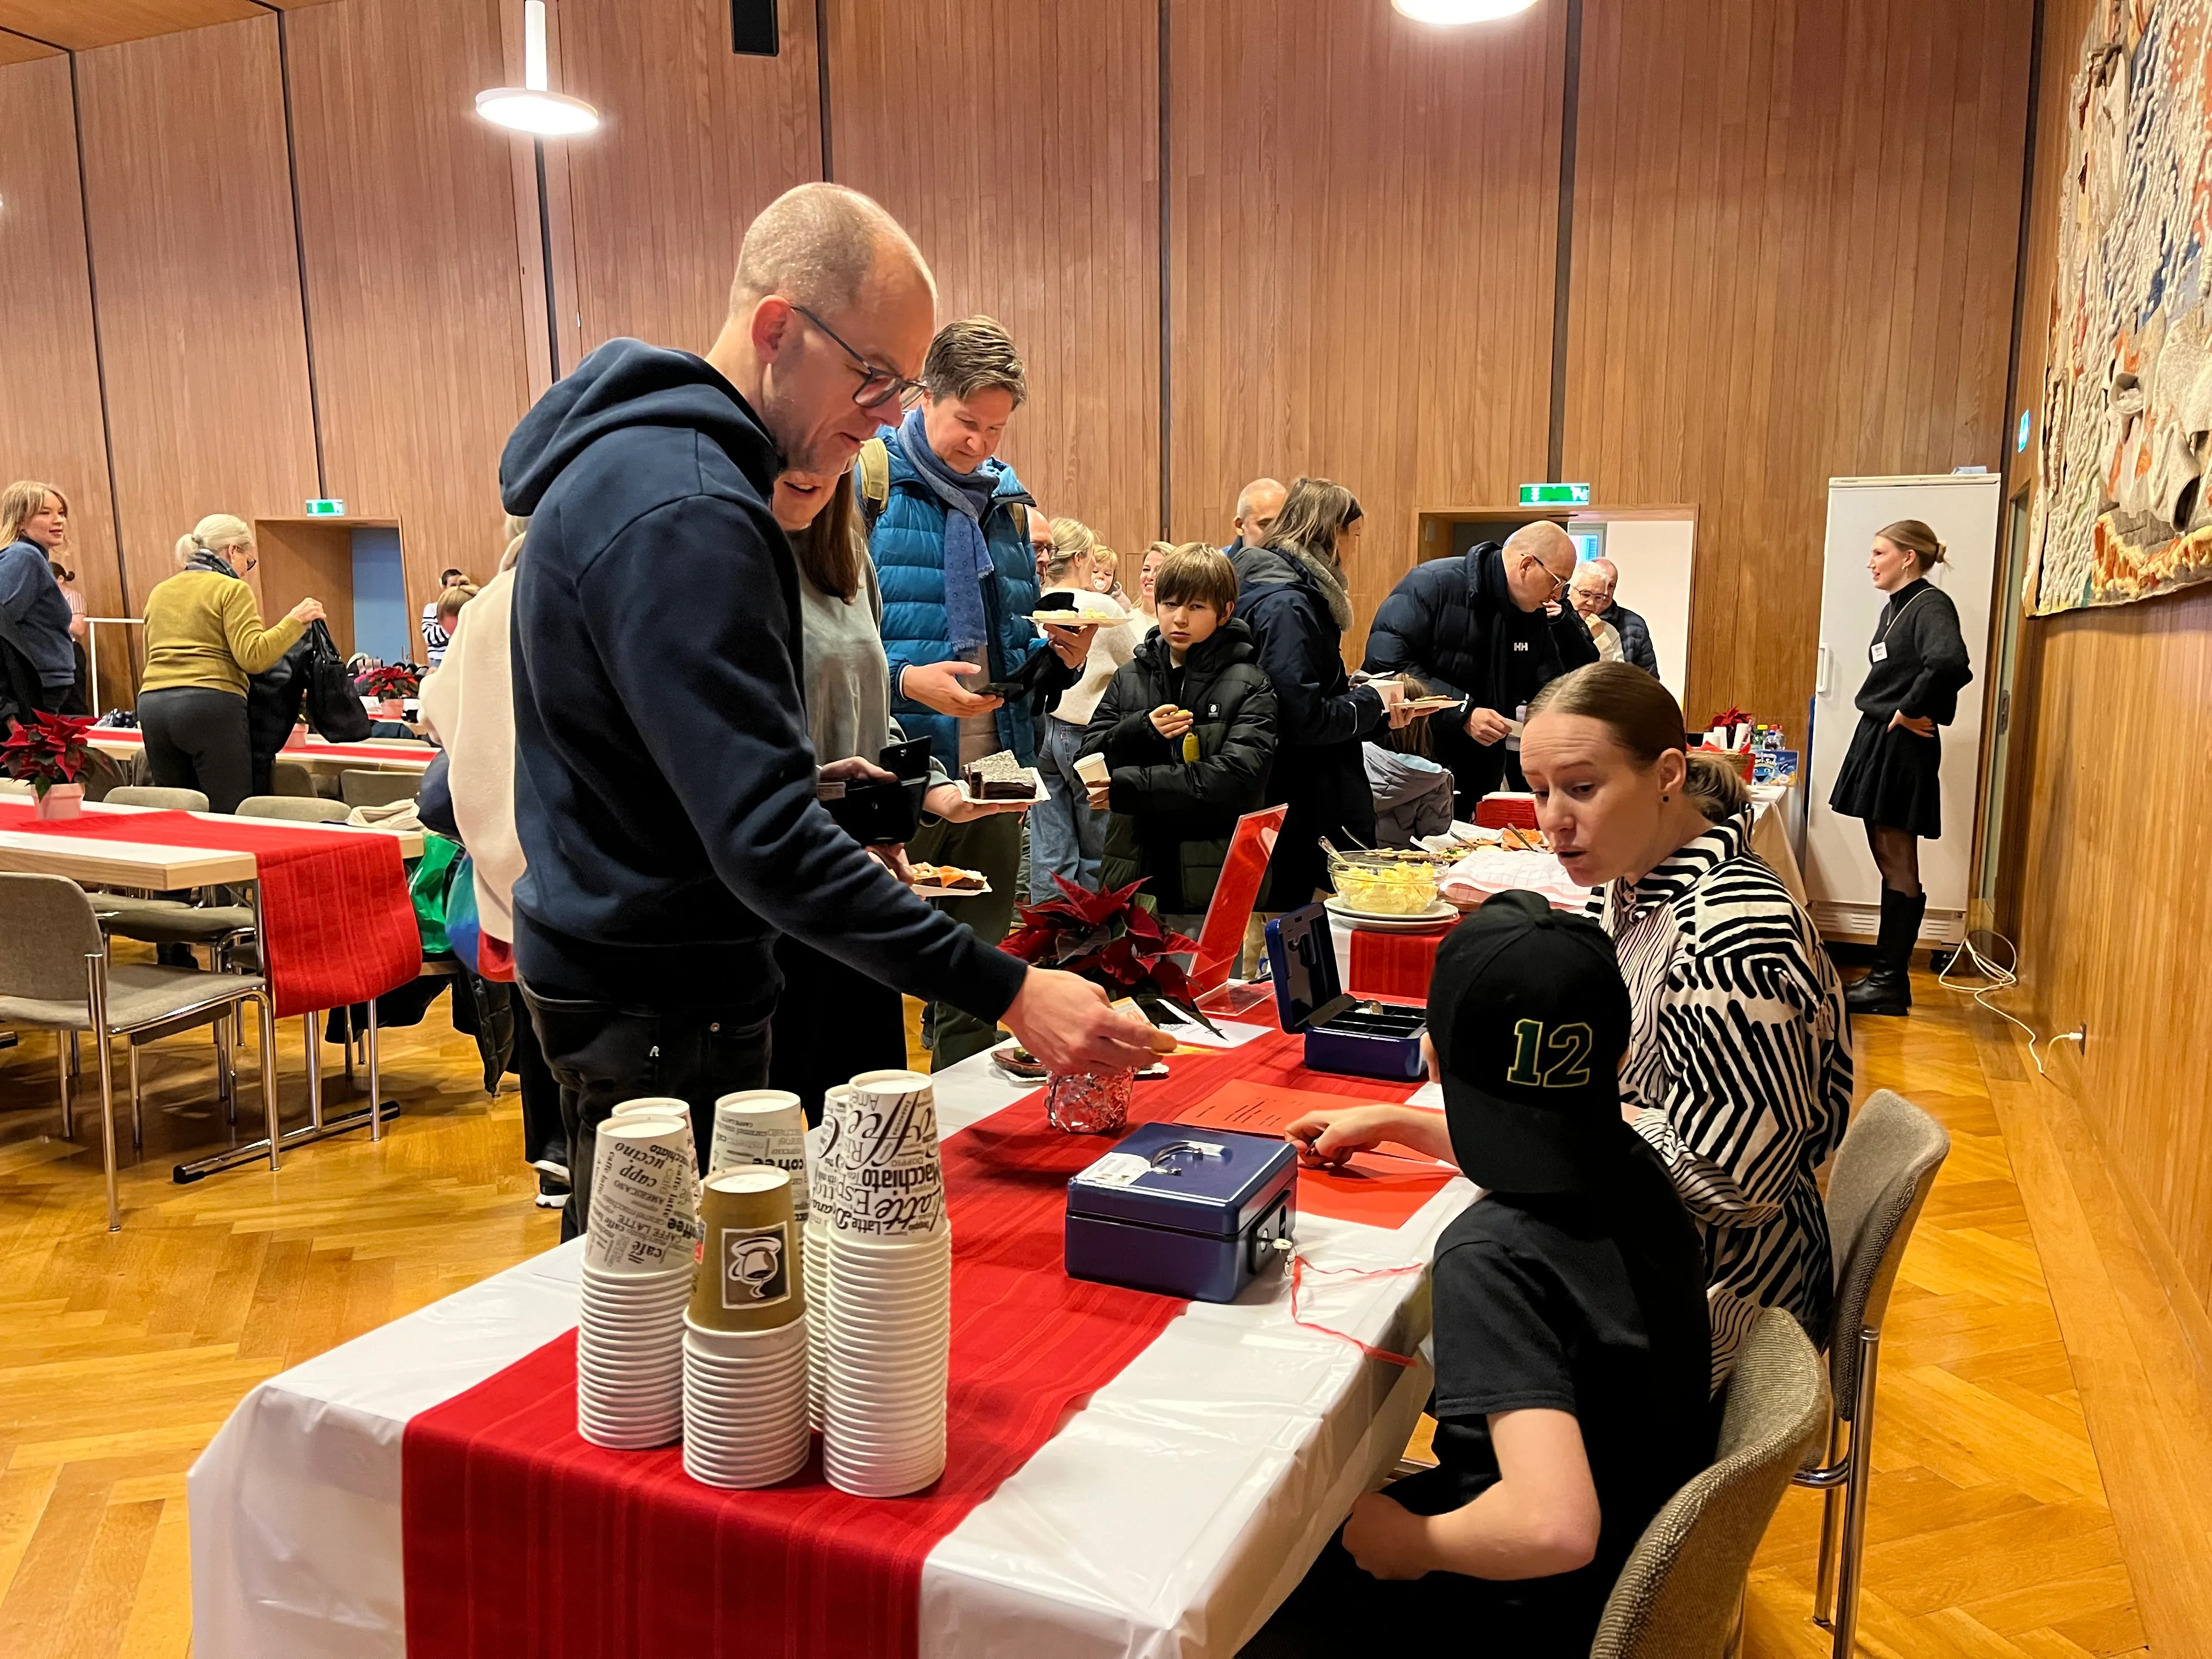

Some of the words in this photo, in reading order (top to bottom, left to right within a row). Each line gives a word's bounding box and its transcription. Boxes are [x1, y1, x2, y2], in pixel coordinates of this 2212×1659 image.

[1514, 642, 1528, 651] HH
[1506, 1018, 1593, 1088] 12
[614, 1142, 665, 1170] uccino
[619, 1165, 657, 1188] capp
[862, 1160, 940, 1195] Macchiato
[874, 1187, 941, 1233] Latte
[617, 1214, 651, 1234] LATTE
[652, 1225, 681, 1244] CAFFE
[851, 1217, 881, 1235] Latte
[631, 1240, 662, 1260] café
